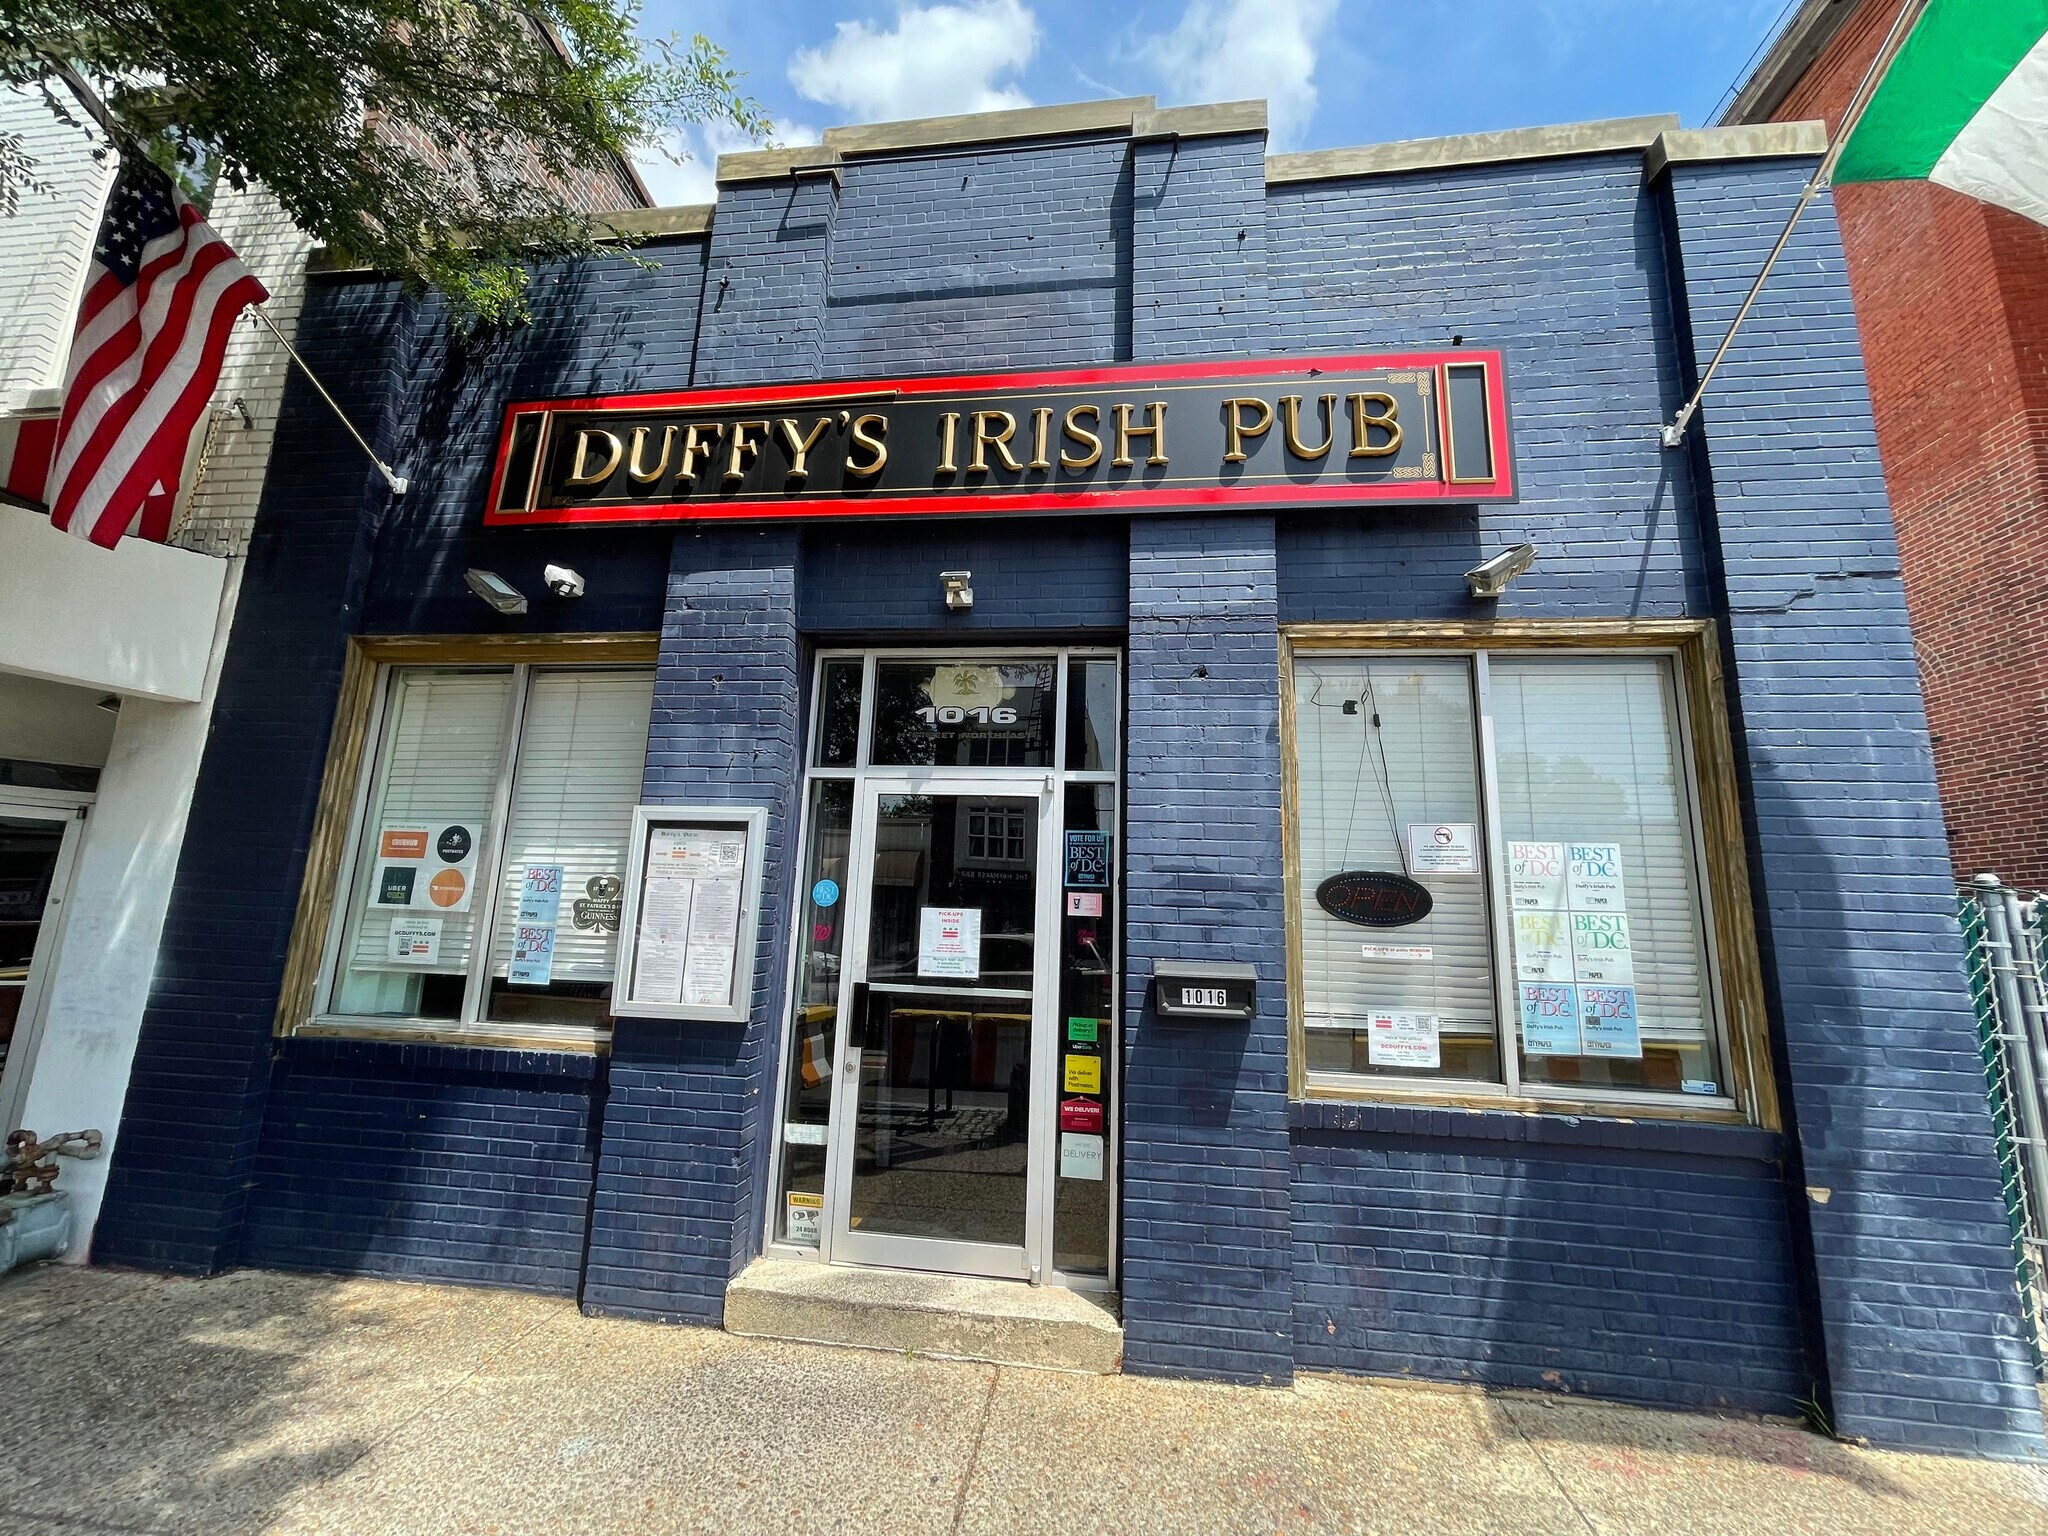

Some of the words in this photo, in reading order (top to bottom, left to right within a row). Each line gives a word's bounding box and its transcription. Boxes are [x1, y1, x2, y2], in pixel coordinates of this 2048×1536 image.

[570, 410, 889, 487] DUFFY'S
[938, 401, 1170, 472] IRISH
[1222, 391, 1404, 462] PUB
[915, 706, 1017, 724] 1016
[1070, 847, 1104, 859] BEST
[1512, 844, 1560, 860] BEST
[1569, 846, 1616, 861] BEST
[1070, 859, 1080, 871] of
[1514, 860, 1528, 875] of
[1573, 862, 1585, 875] of
[526, 868, 560, 880] BEST
[526, 880, 534, 890] of
[1326, 886, 1420, 913] OPEN
[581, 911, 617, 921] GUINNESS
[1572, 914, 1626, 931] BEST
[1520, 916, 1563, 930] BEST
[519, 928, 552, 940] BEST
[1577, 932, 1589, 947] of
[518, 940, 528, 950] of
[1185, 989, 1224, 1005] 1016
[1524, 987, 1571, 1002] BEST
[1583, 989, 1630, 1004] BEST
[1526, 1001, 1538, 1014] of
[1586, 1003, 1597, 1015] of
[1063, 1149, 1102, 1159] DELIVERY
[793, 1197, 820, 1205] WARNING
